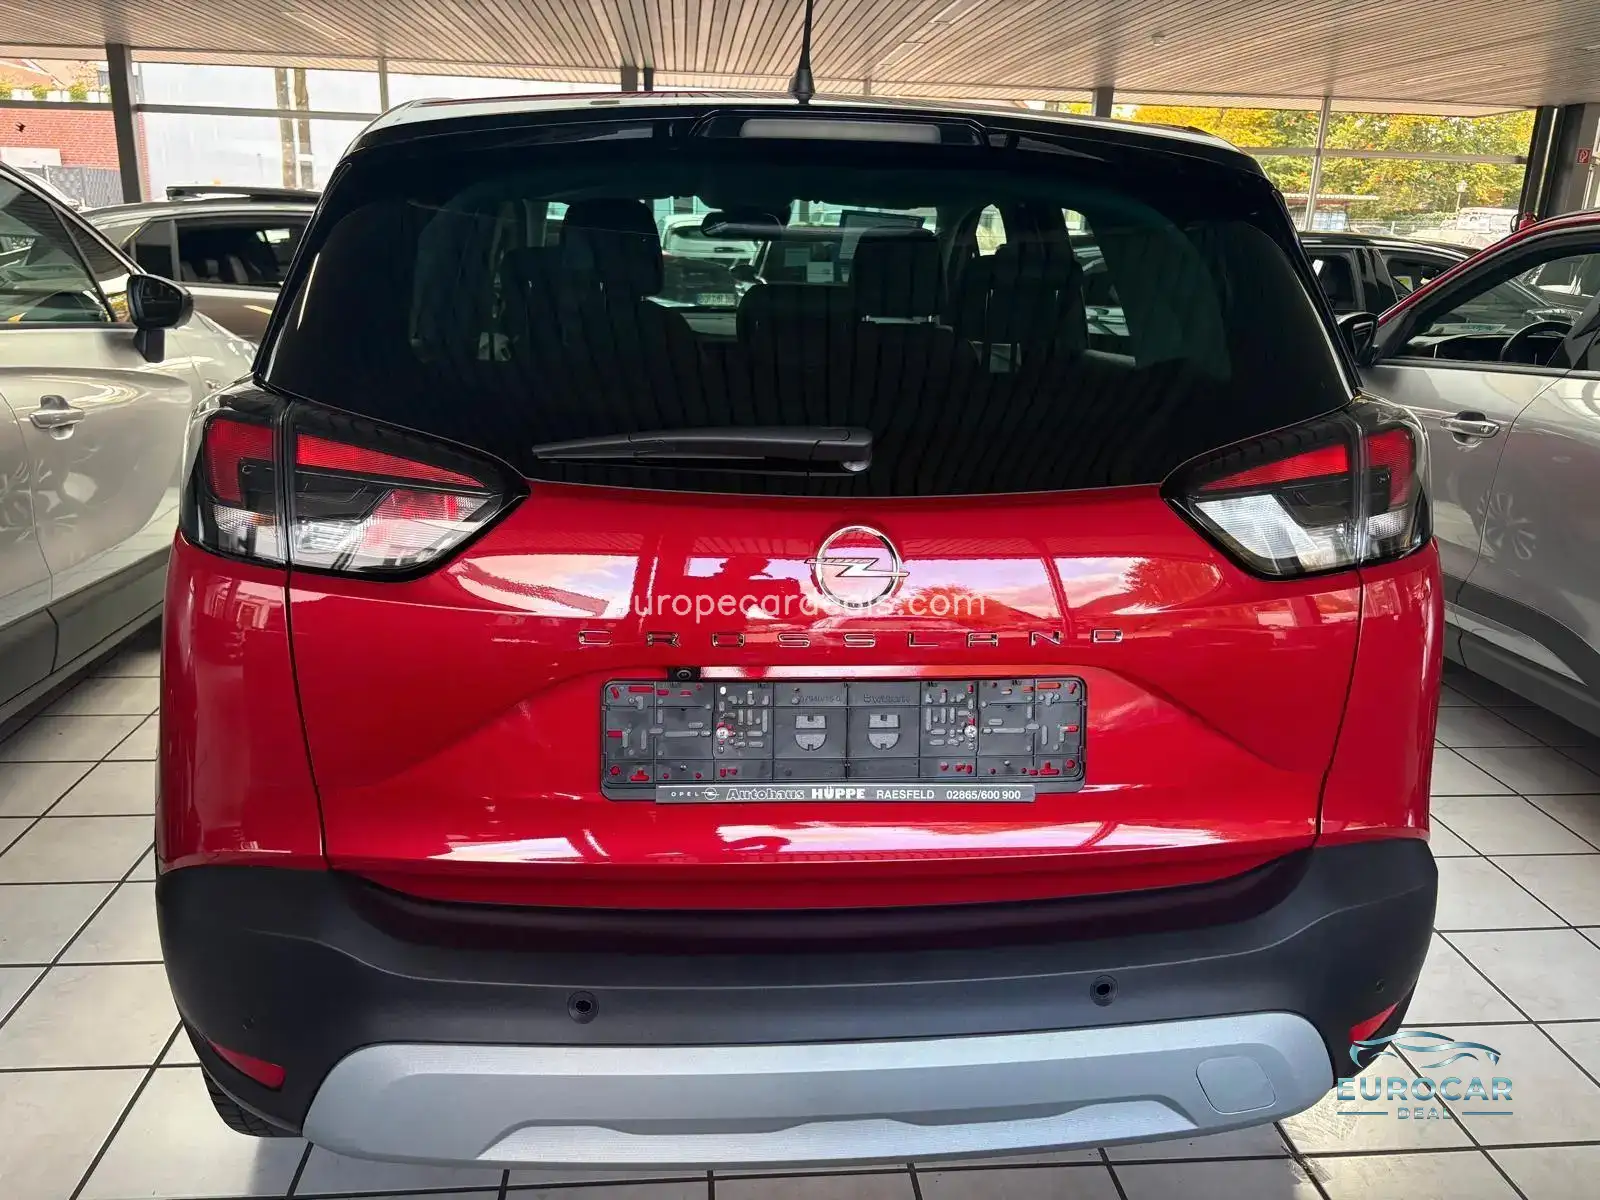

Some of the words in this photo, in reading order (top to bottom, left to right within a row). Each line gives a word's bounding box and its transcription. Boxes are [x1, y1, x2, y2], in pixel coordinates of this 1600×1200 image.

[578, 629, 1124, 648] CROSSLAND
[725, 787, 804, 800] Autohaus
[811, 785, 866, 800] HÜPPE
[876, 789, 935, 800] RAESFELD
[946, 790, 999, 801] 02865/600
[1001, 790, 1021, 800] 900
